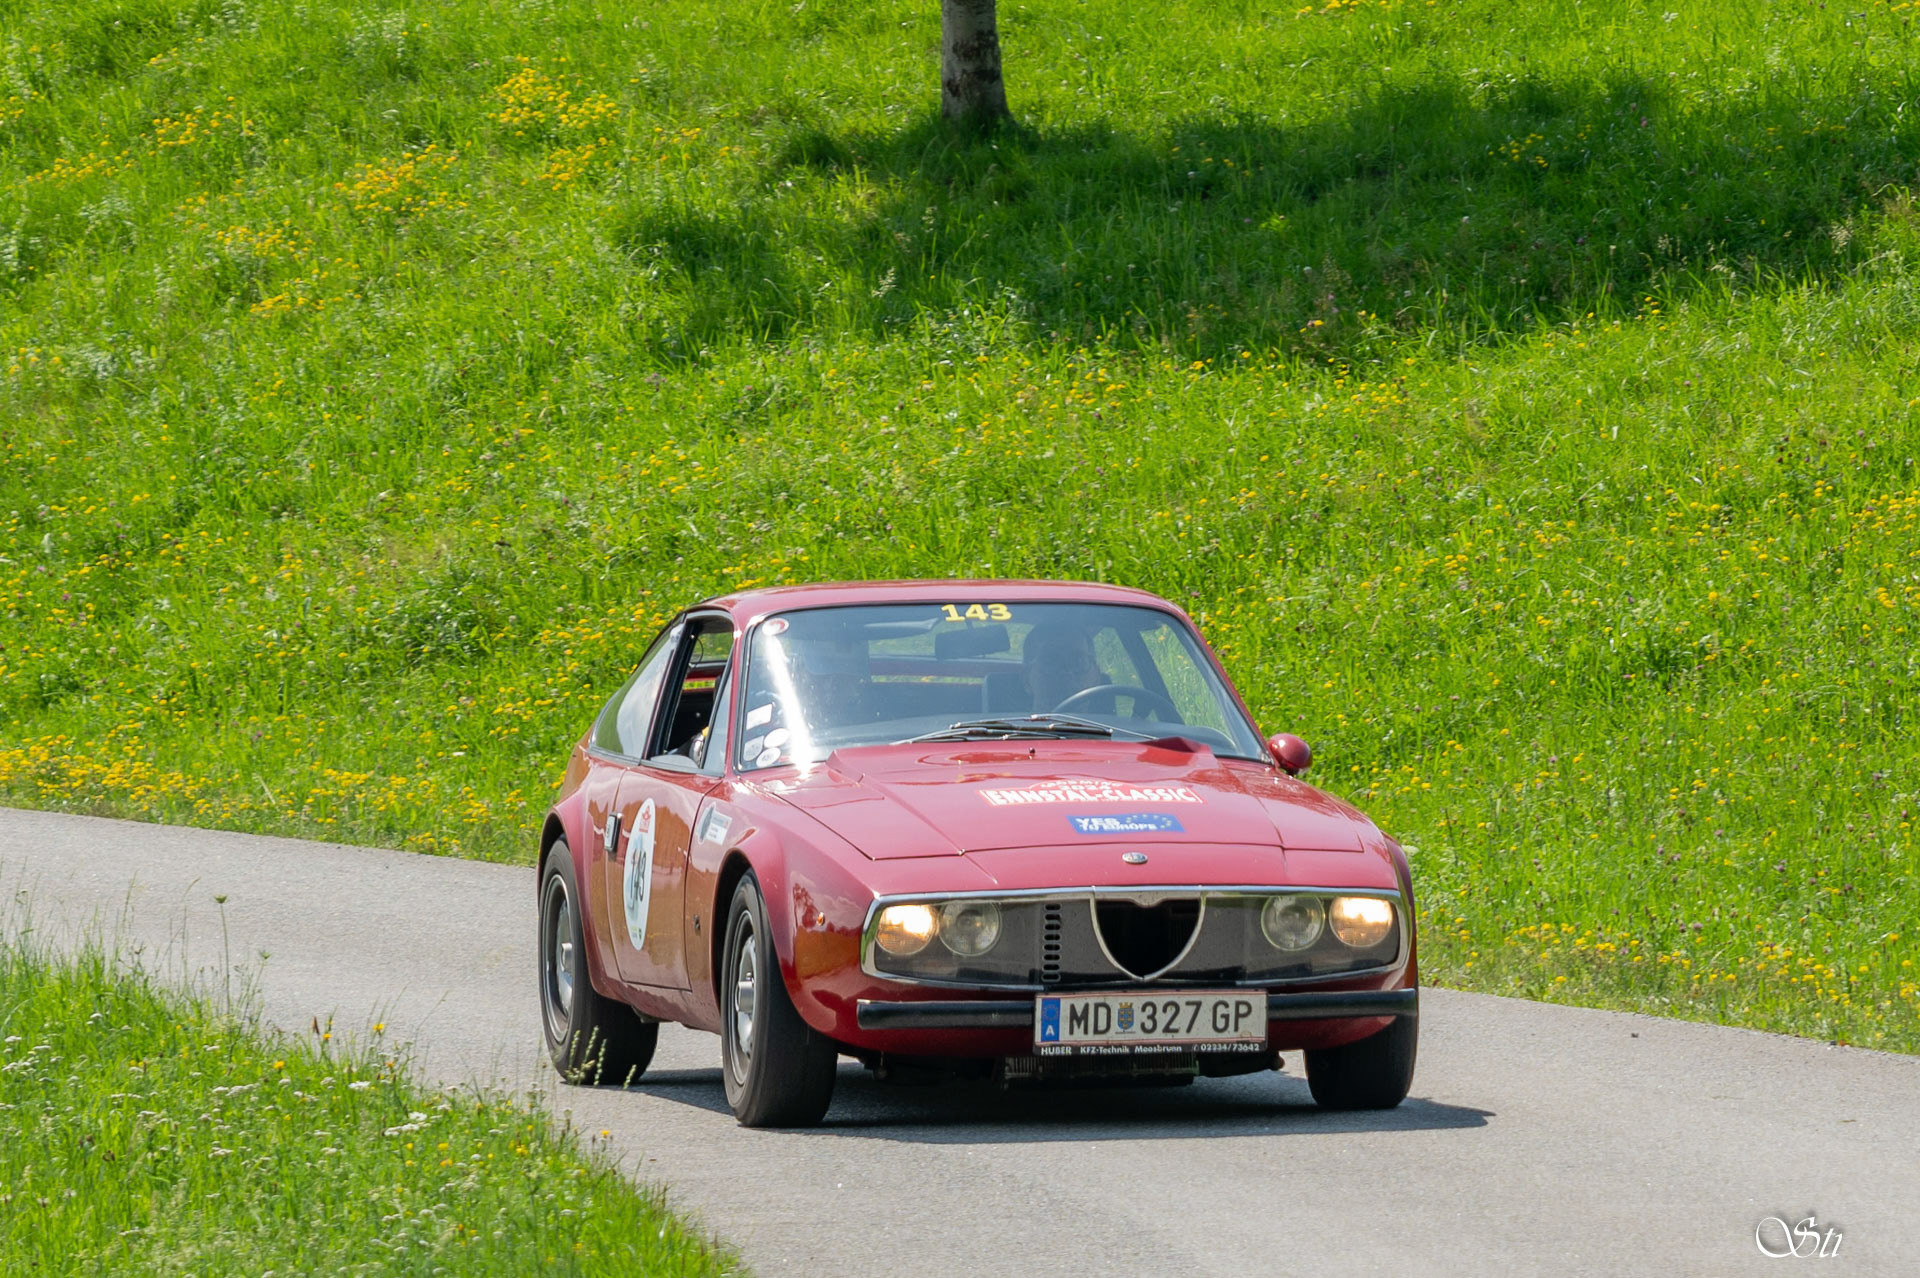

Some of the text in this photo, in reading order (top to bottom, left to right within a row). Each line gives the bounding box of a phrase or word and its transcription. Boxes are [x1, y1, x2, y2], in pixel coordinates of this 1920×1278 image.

[941, 603, 1012, 621] 143
[988, 787, 1197, 805] ENNSTAL-CLASSIC
[1075, 818, 1119, 827] YES
[1068, 1000, 1252, 1035] MD 327 GP
[1045, 1025, 1055, 1036] A
[1041, 1046, 1072, 1056] HUBER
[1080, 1045, 1130, 1054] KFZ-Technik
